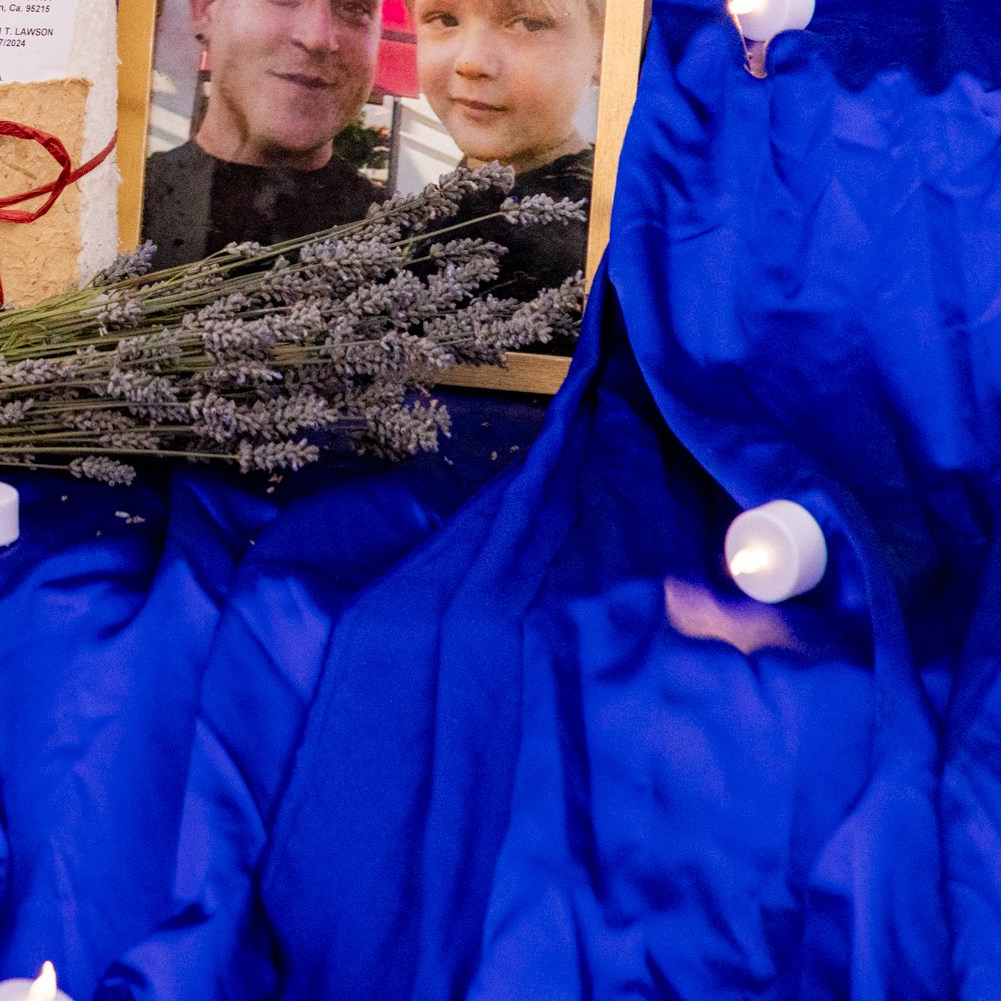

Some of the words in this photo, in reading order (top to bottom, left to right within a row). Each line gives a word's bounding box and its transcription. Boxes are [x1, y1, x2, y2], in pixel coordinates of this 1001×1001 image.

[9, 4, 23, 12] Ca.
[5, 27, 12, 35] T.
[15, 28, 53, 36] LAWSON
